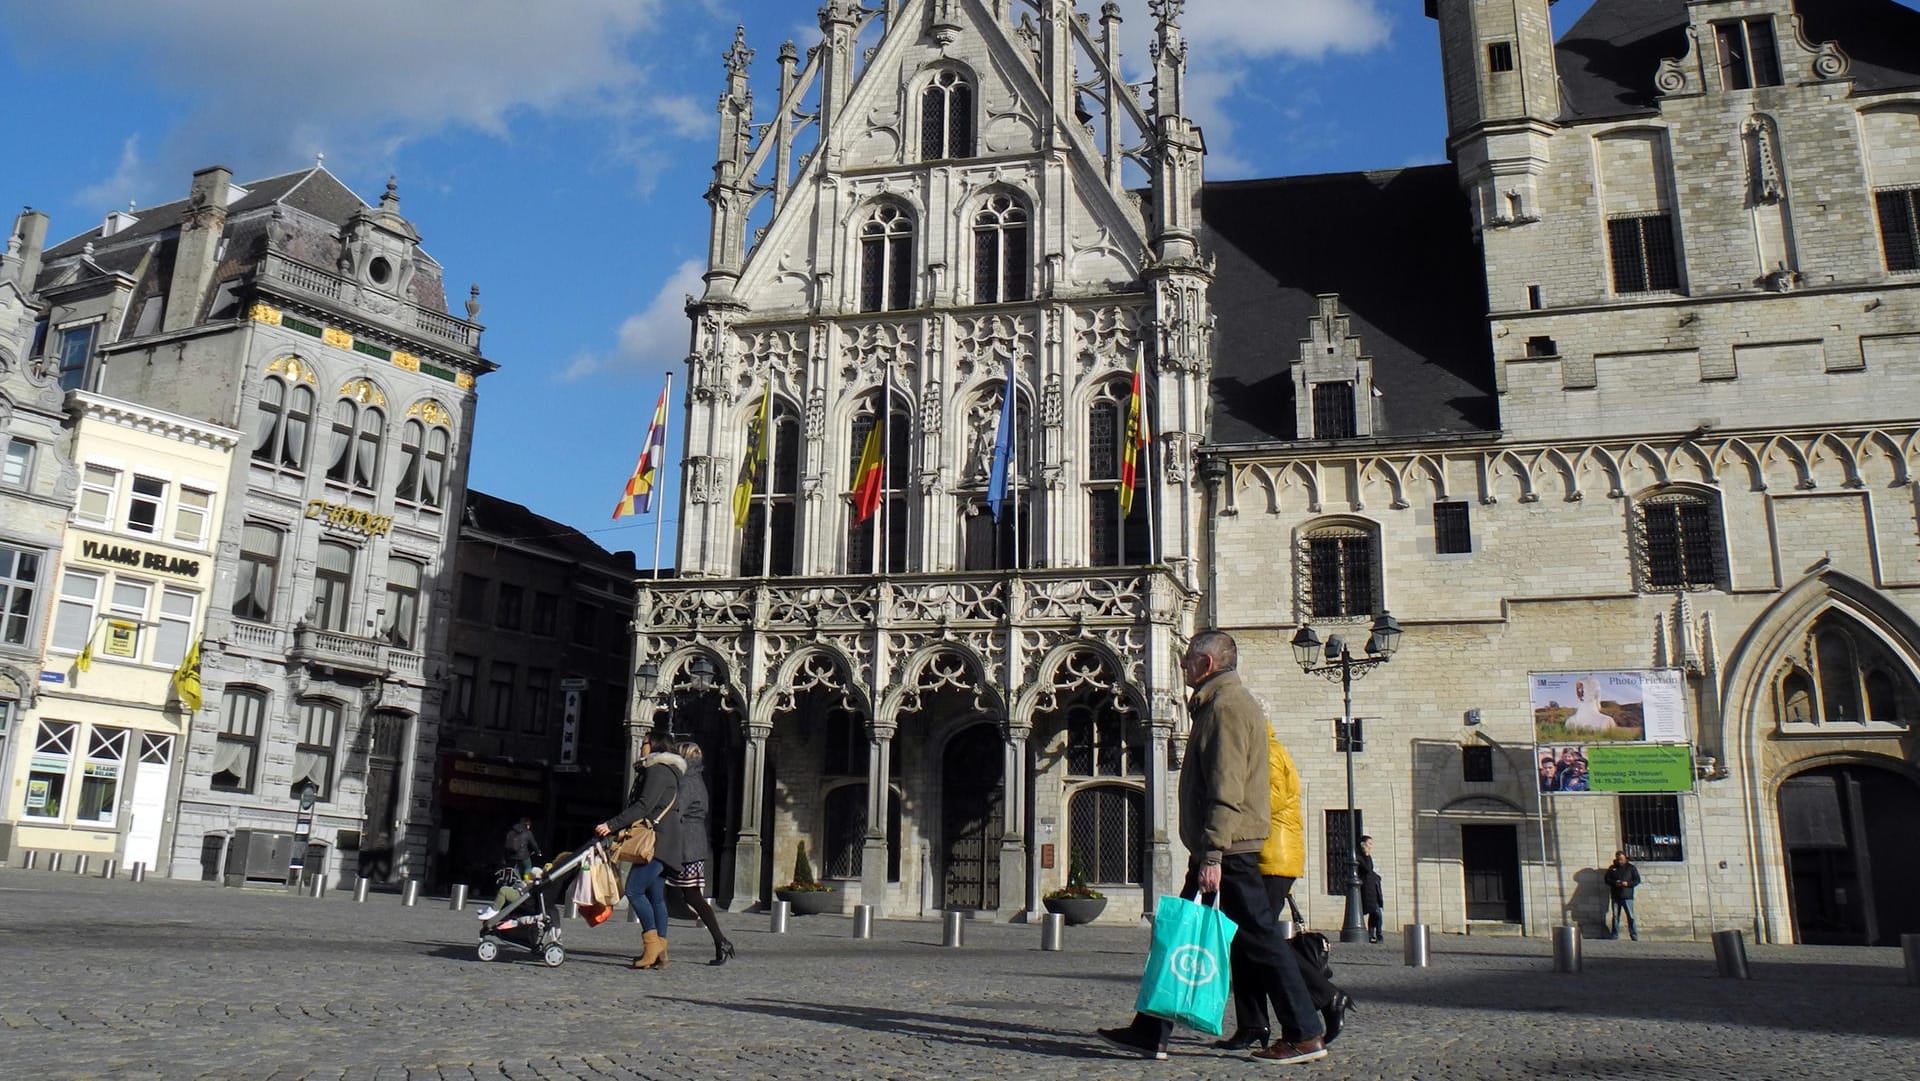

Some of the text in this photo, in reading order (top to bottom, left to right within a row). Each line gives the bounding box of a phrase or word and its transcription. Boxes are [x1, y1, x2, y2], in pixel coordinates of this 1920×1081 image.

[83, 540, 200, 577] VLAAMS BELANG
[1609, 677, 1637, 685] Photo
[1653, 836, 1668, 844] WC
[1179, 953, 1208, 977] C&A
